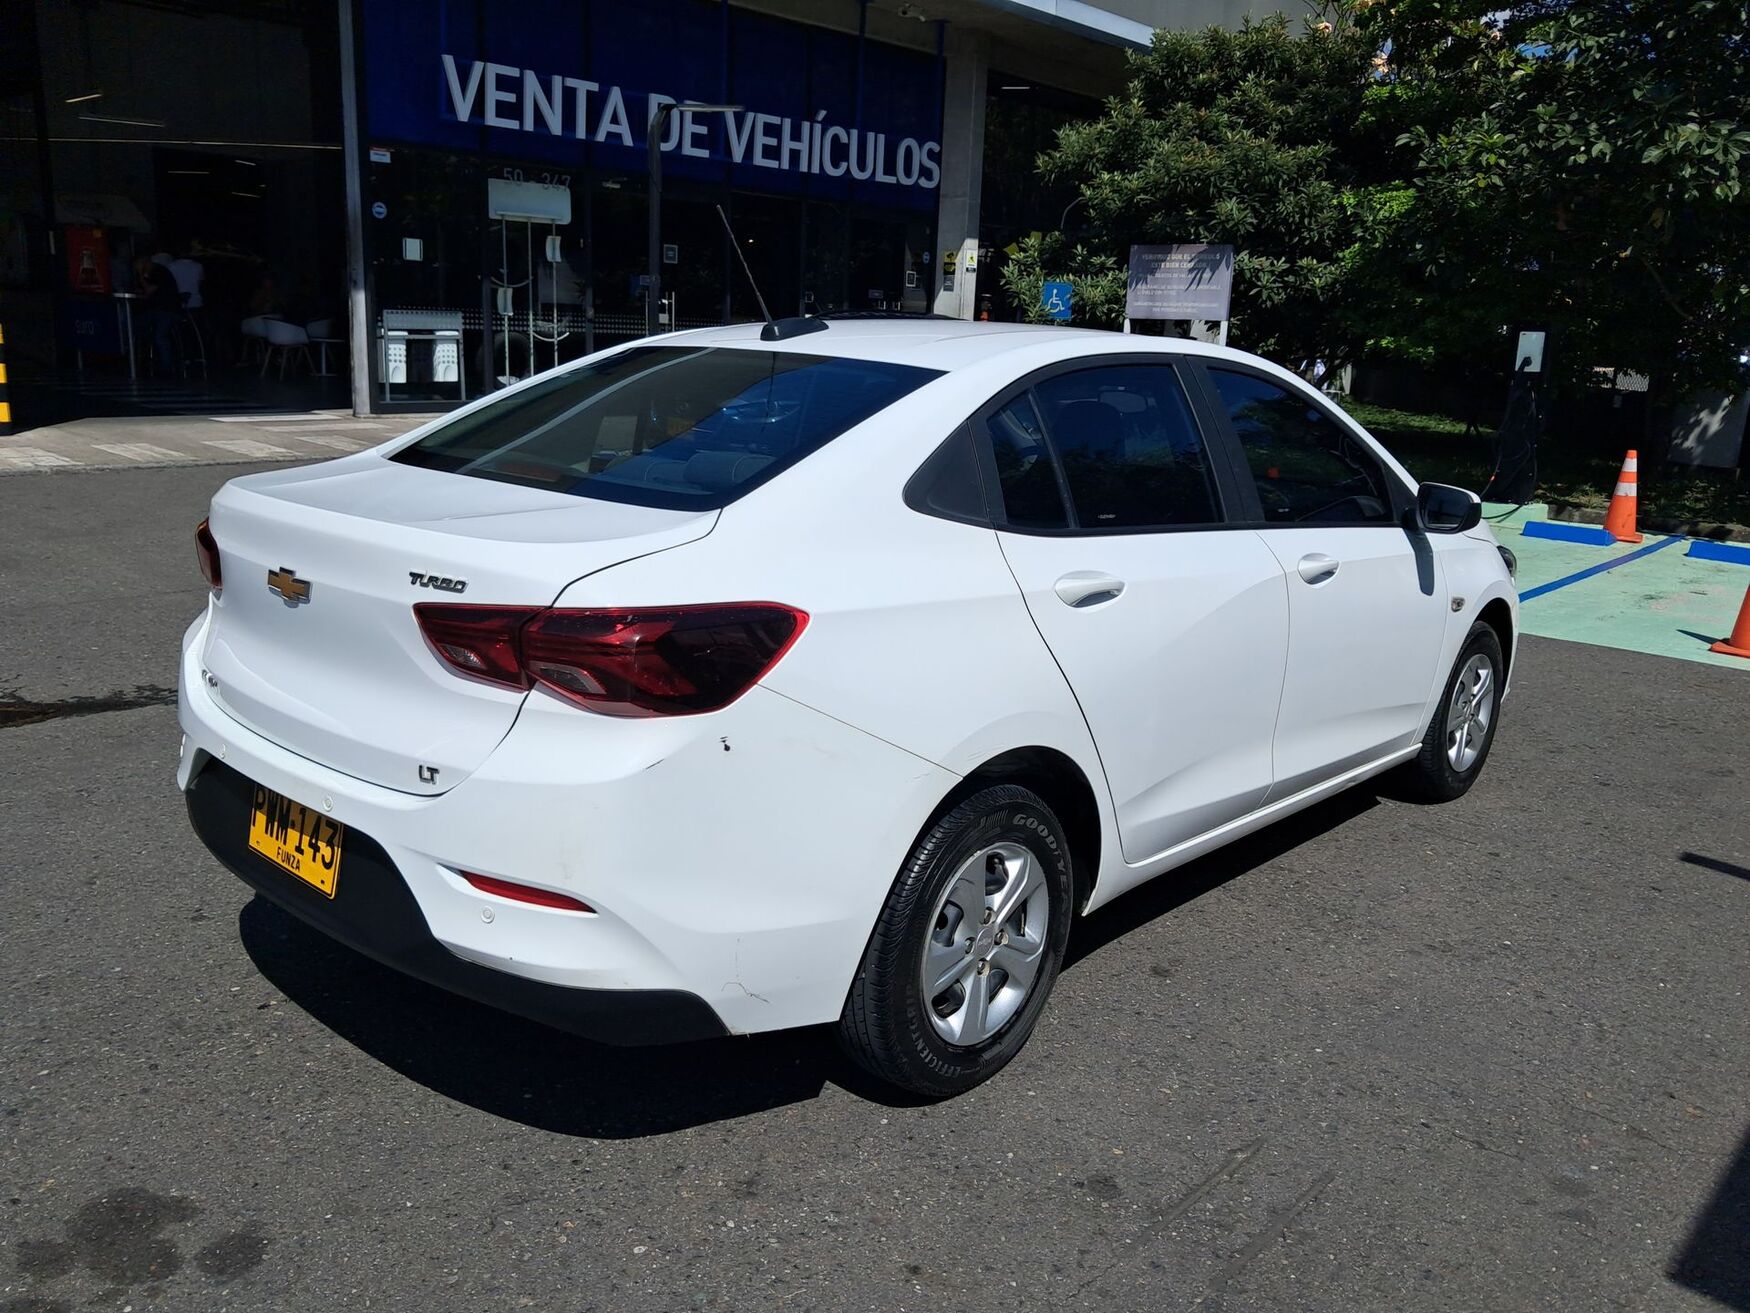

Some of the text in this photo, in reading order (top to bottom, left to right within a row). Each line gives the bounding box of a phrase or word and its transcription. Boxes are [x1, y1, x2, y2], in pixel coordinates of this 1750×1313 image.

[442, 54, 942, 189] VENTA DE VEHÍCULOS
[408, 571, 467, 594] TURBO
[418, 764, 440, 785] LT
[276, 847, 301, 873] FUNZA
